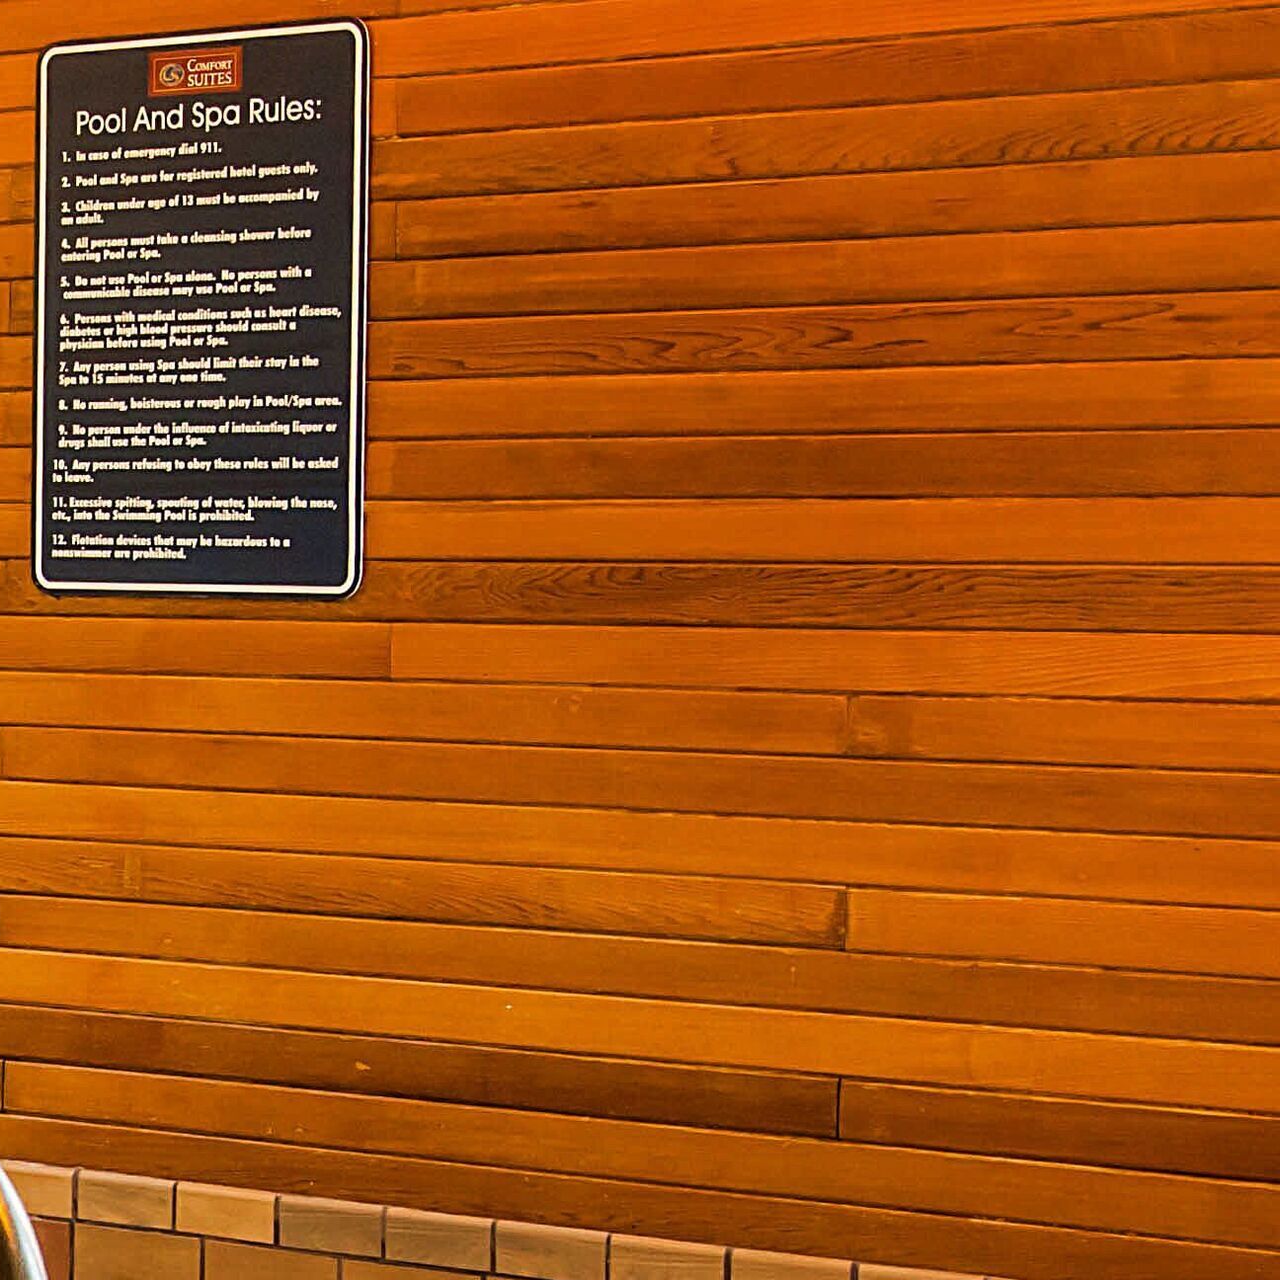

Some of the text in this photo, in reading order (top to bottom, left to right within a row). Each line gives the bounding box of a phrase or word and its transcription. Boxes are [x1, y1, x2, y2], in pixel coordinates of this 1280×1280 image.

[186, 70, 232, 87] SUITES
[76, 93, 321, 135] Pool And Spa Rules:
[62, 140, 221, 162] 1. In case of emergency dial 911.
[61, 160, 317, 187] 2. Pool and Spa are for registered hotel guests only.
[61, 186, 319, 213] 3. Children under age of 13 must be accompanied by
[60, 212, 103, 225] an adult.
[61, 225, 311, 249] 4. All persons must take a cleansing shower before
[60, 246, 161, 263] entering Pool or Spa.
[59, 354, 318, 373] 7. Any person using Spa should limit their stay in the
[58, 369, 226, 386] Spa to 15 minutes at any one time.
[58, 394, 342, 411] 8. No running, boisterous or rough play in Pool/Spa area.
[53, 456, 338, 472] 10. Any persons refusing to obey these rules will be asked
[52, 472, 94, 482] to leave.
[52, 495, 337, 509] 11. Excessive spitting, spouting of water, blowing the nose,
[51, 509, 254, 522] etc., into the Swimming Pool is prohibited.
[52, 533, 290, 547] 12. Flotation devices that may be hazardous to a
[51, 546, 186, 559] nonswimmer are prohibited.
